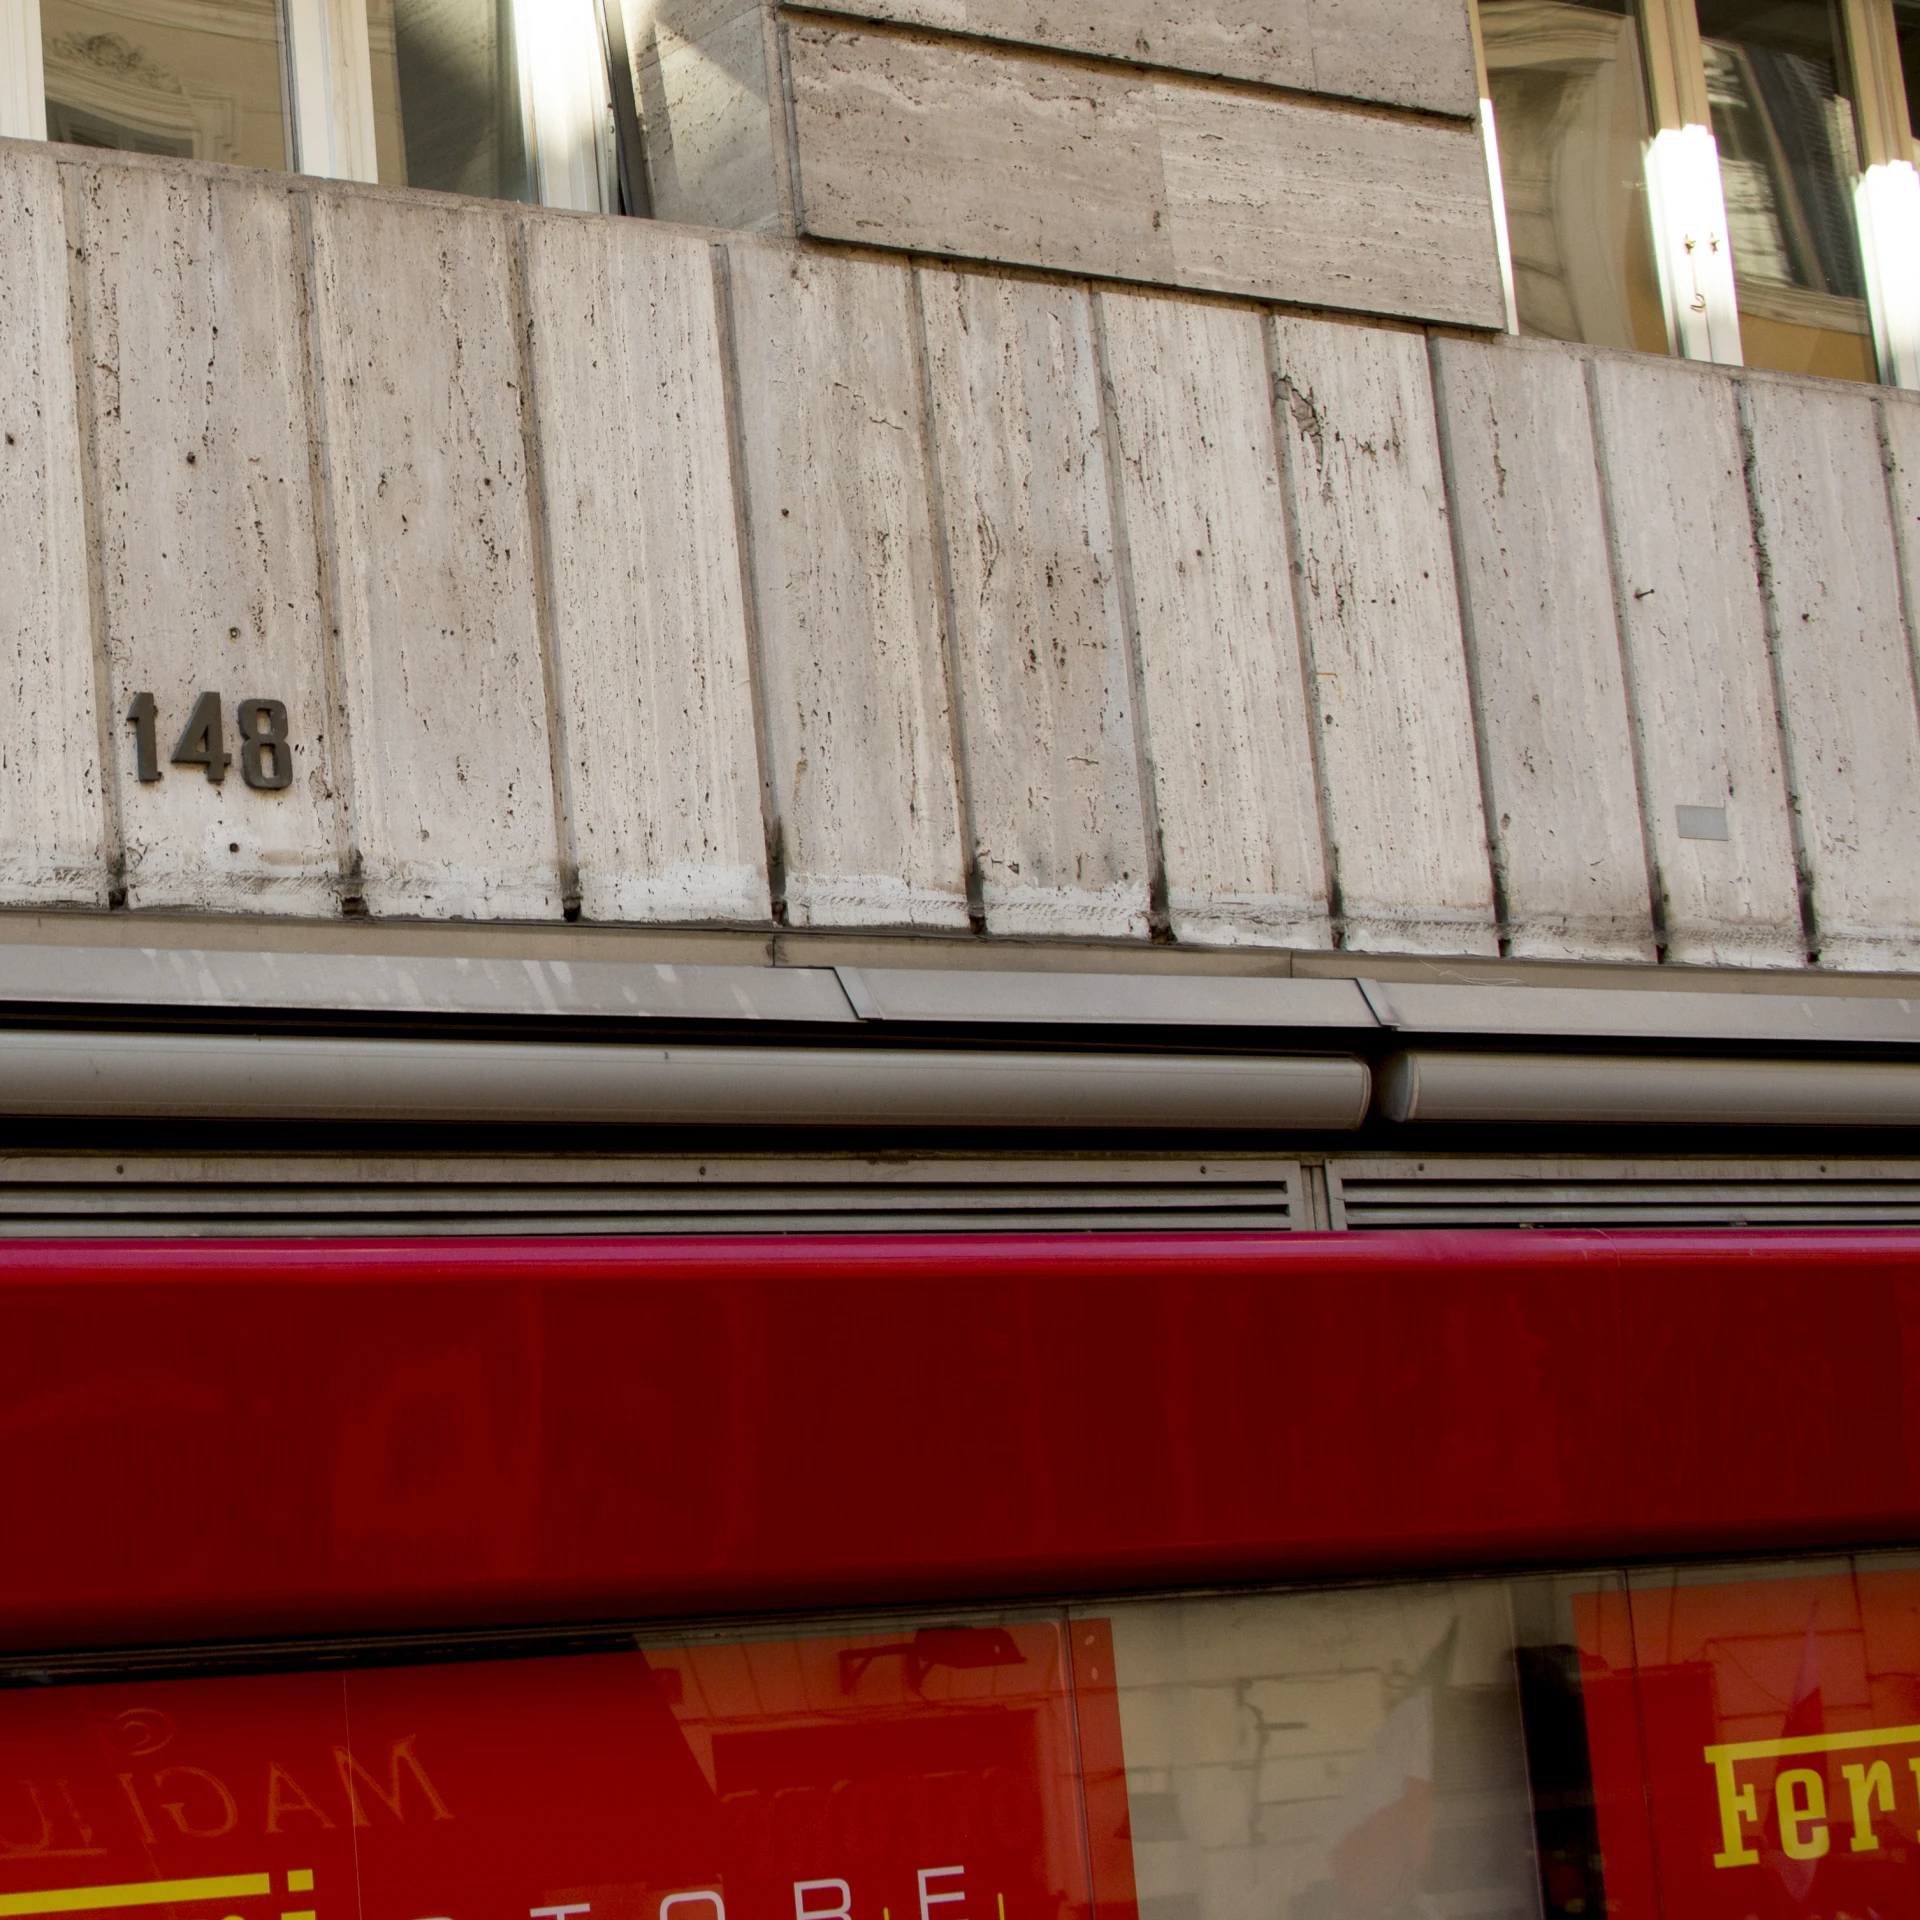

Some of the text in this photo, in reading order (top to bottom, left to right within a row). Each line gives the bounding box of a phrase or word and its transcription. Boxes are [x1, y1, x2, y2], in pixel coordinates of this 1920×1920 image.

[126, 691, 293, 790] 148
[1704, 1724, 1920, 1869] Fer
[412, 1865, 967, 1920] ORE
